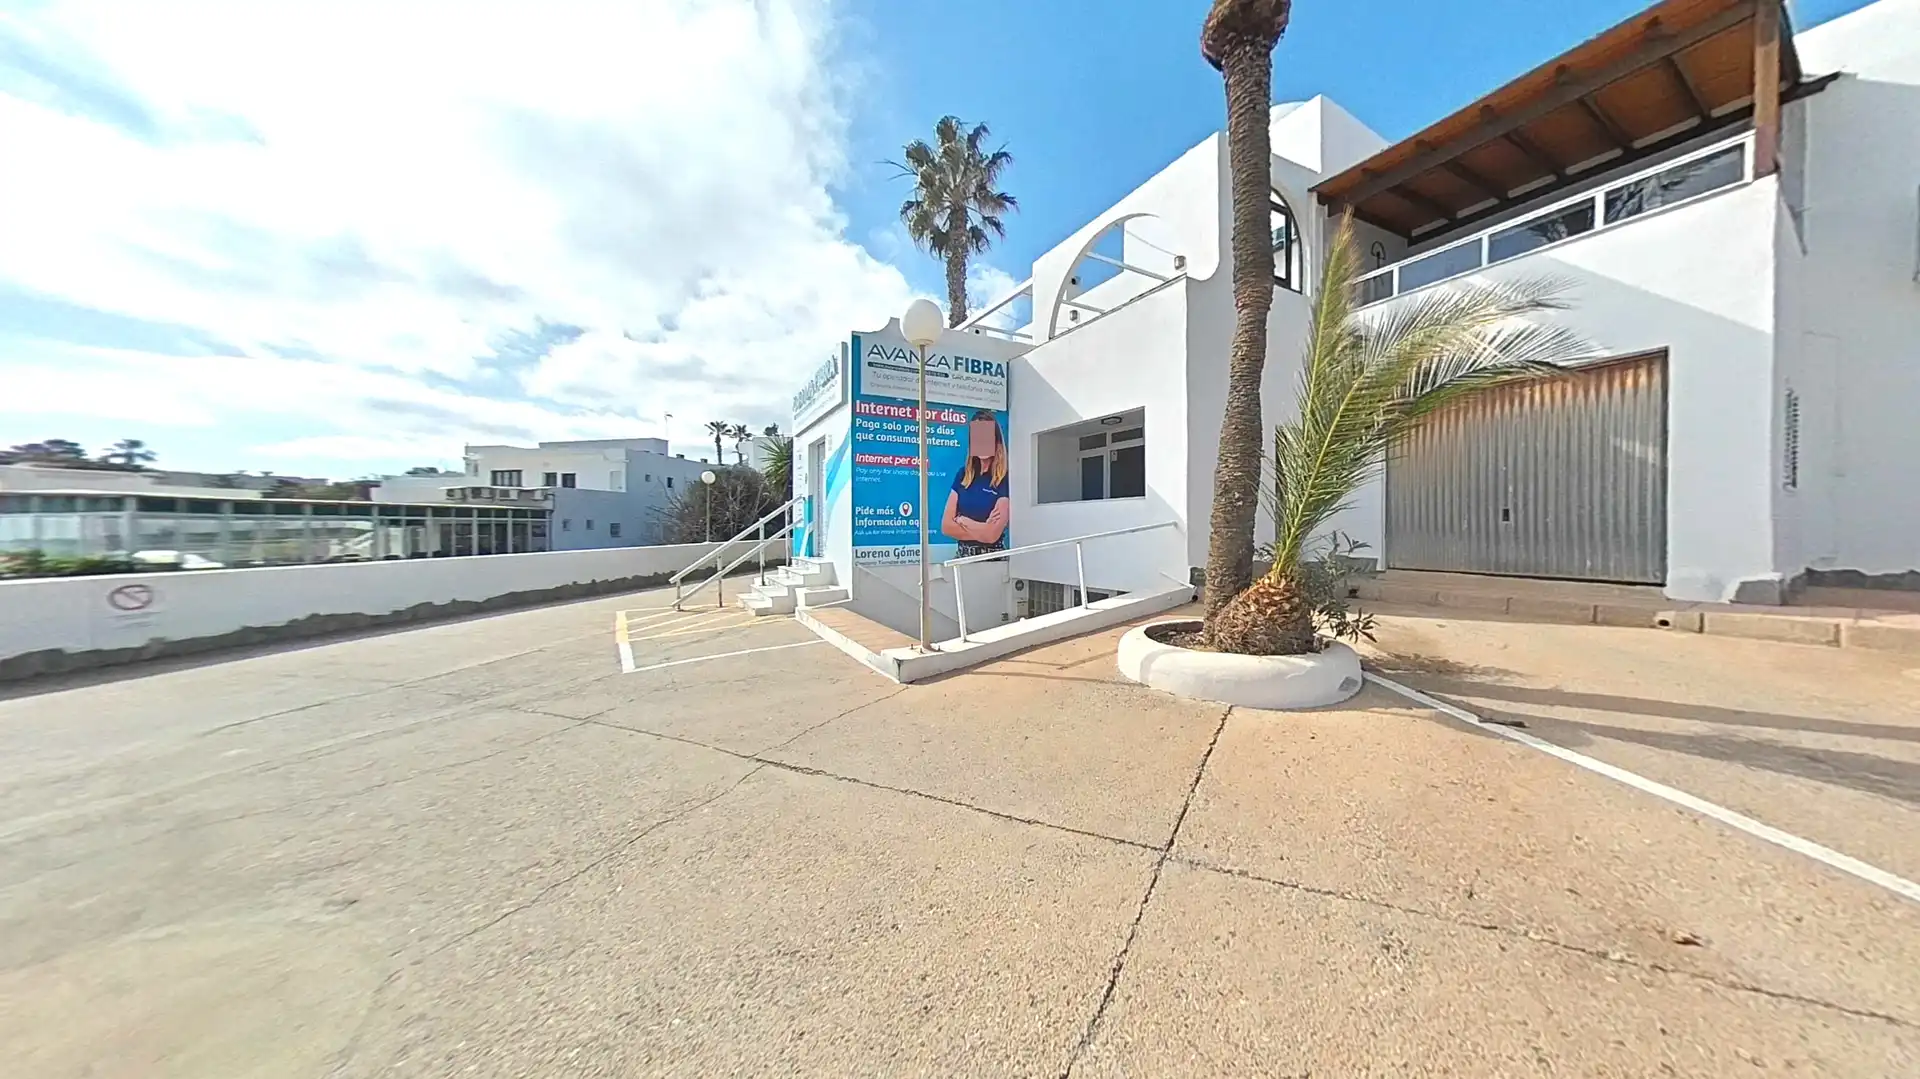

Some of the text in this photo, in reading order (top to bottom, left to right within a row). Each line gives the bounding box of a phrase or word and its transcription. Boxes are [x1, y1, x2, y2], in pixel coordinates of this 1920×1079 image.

[868, 344, 950, 368] AVANZA
[954, 356, 1005, 378] FIBRA
[856, 400, 912, 418] Internet
[940, 408, 966, 423] días
[856, 418, 880, 430] Paga
[882, 421, 902, 431] solo
[904, 424, 918, 434] por
[936, 424, 954, 436] días
[856, 432, 960, 446] que consumas nternet.
[856, 454, 928, 466] Internet per da
[855, 506, 894, 515] Pide más
[909, 519, 920, 528] aq
[855, 546, 920, 560] Lorena Góme
